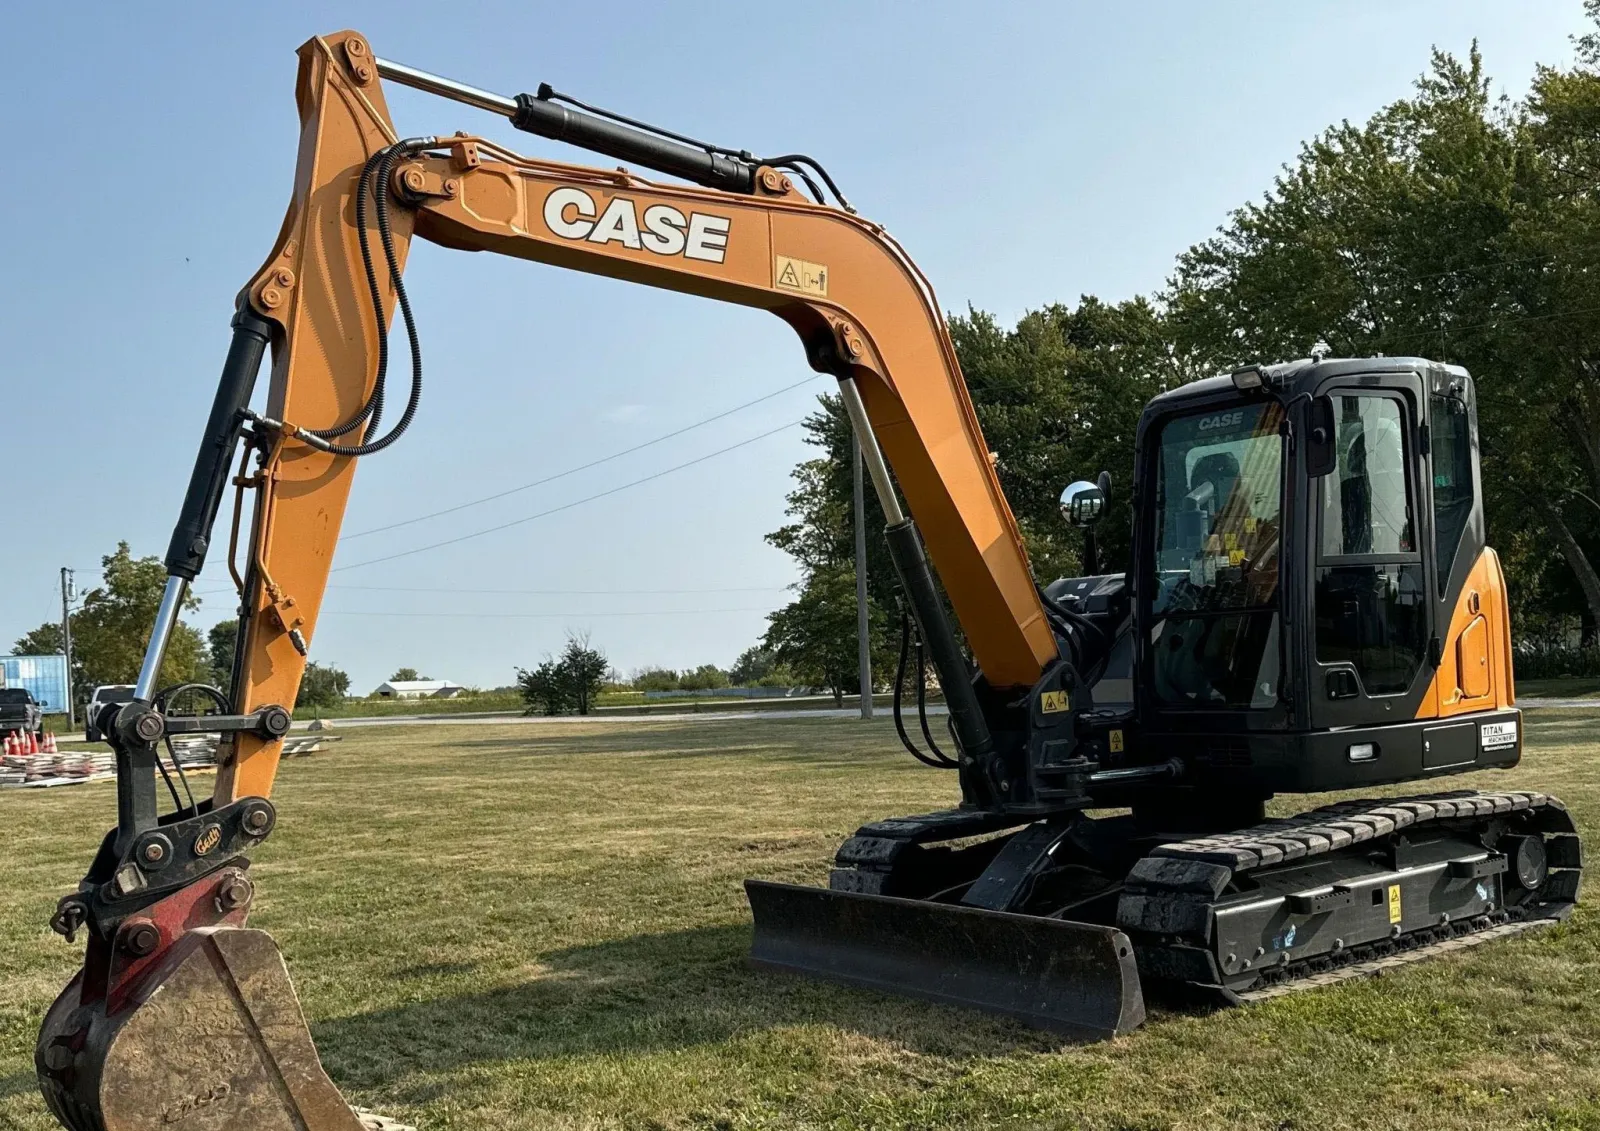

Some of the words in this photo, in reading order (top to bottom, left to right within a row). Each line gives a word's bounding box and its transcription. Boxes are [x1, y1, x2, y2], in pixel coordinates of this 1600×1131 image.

[542, 186, 732, 264] CASE
[1199, 412, 1243, 430] CASE
[1483, 725, 1503, 735] TITAN
